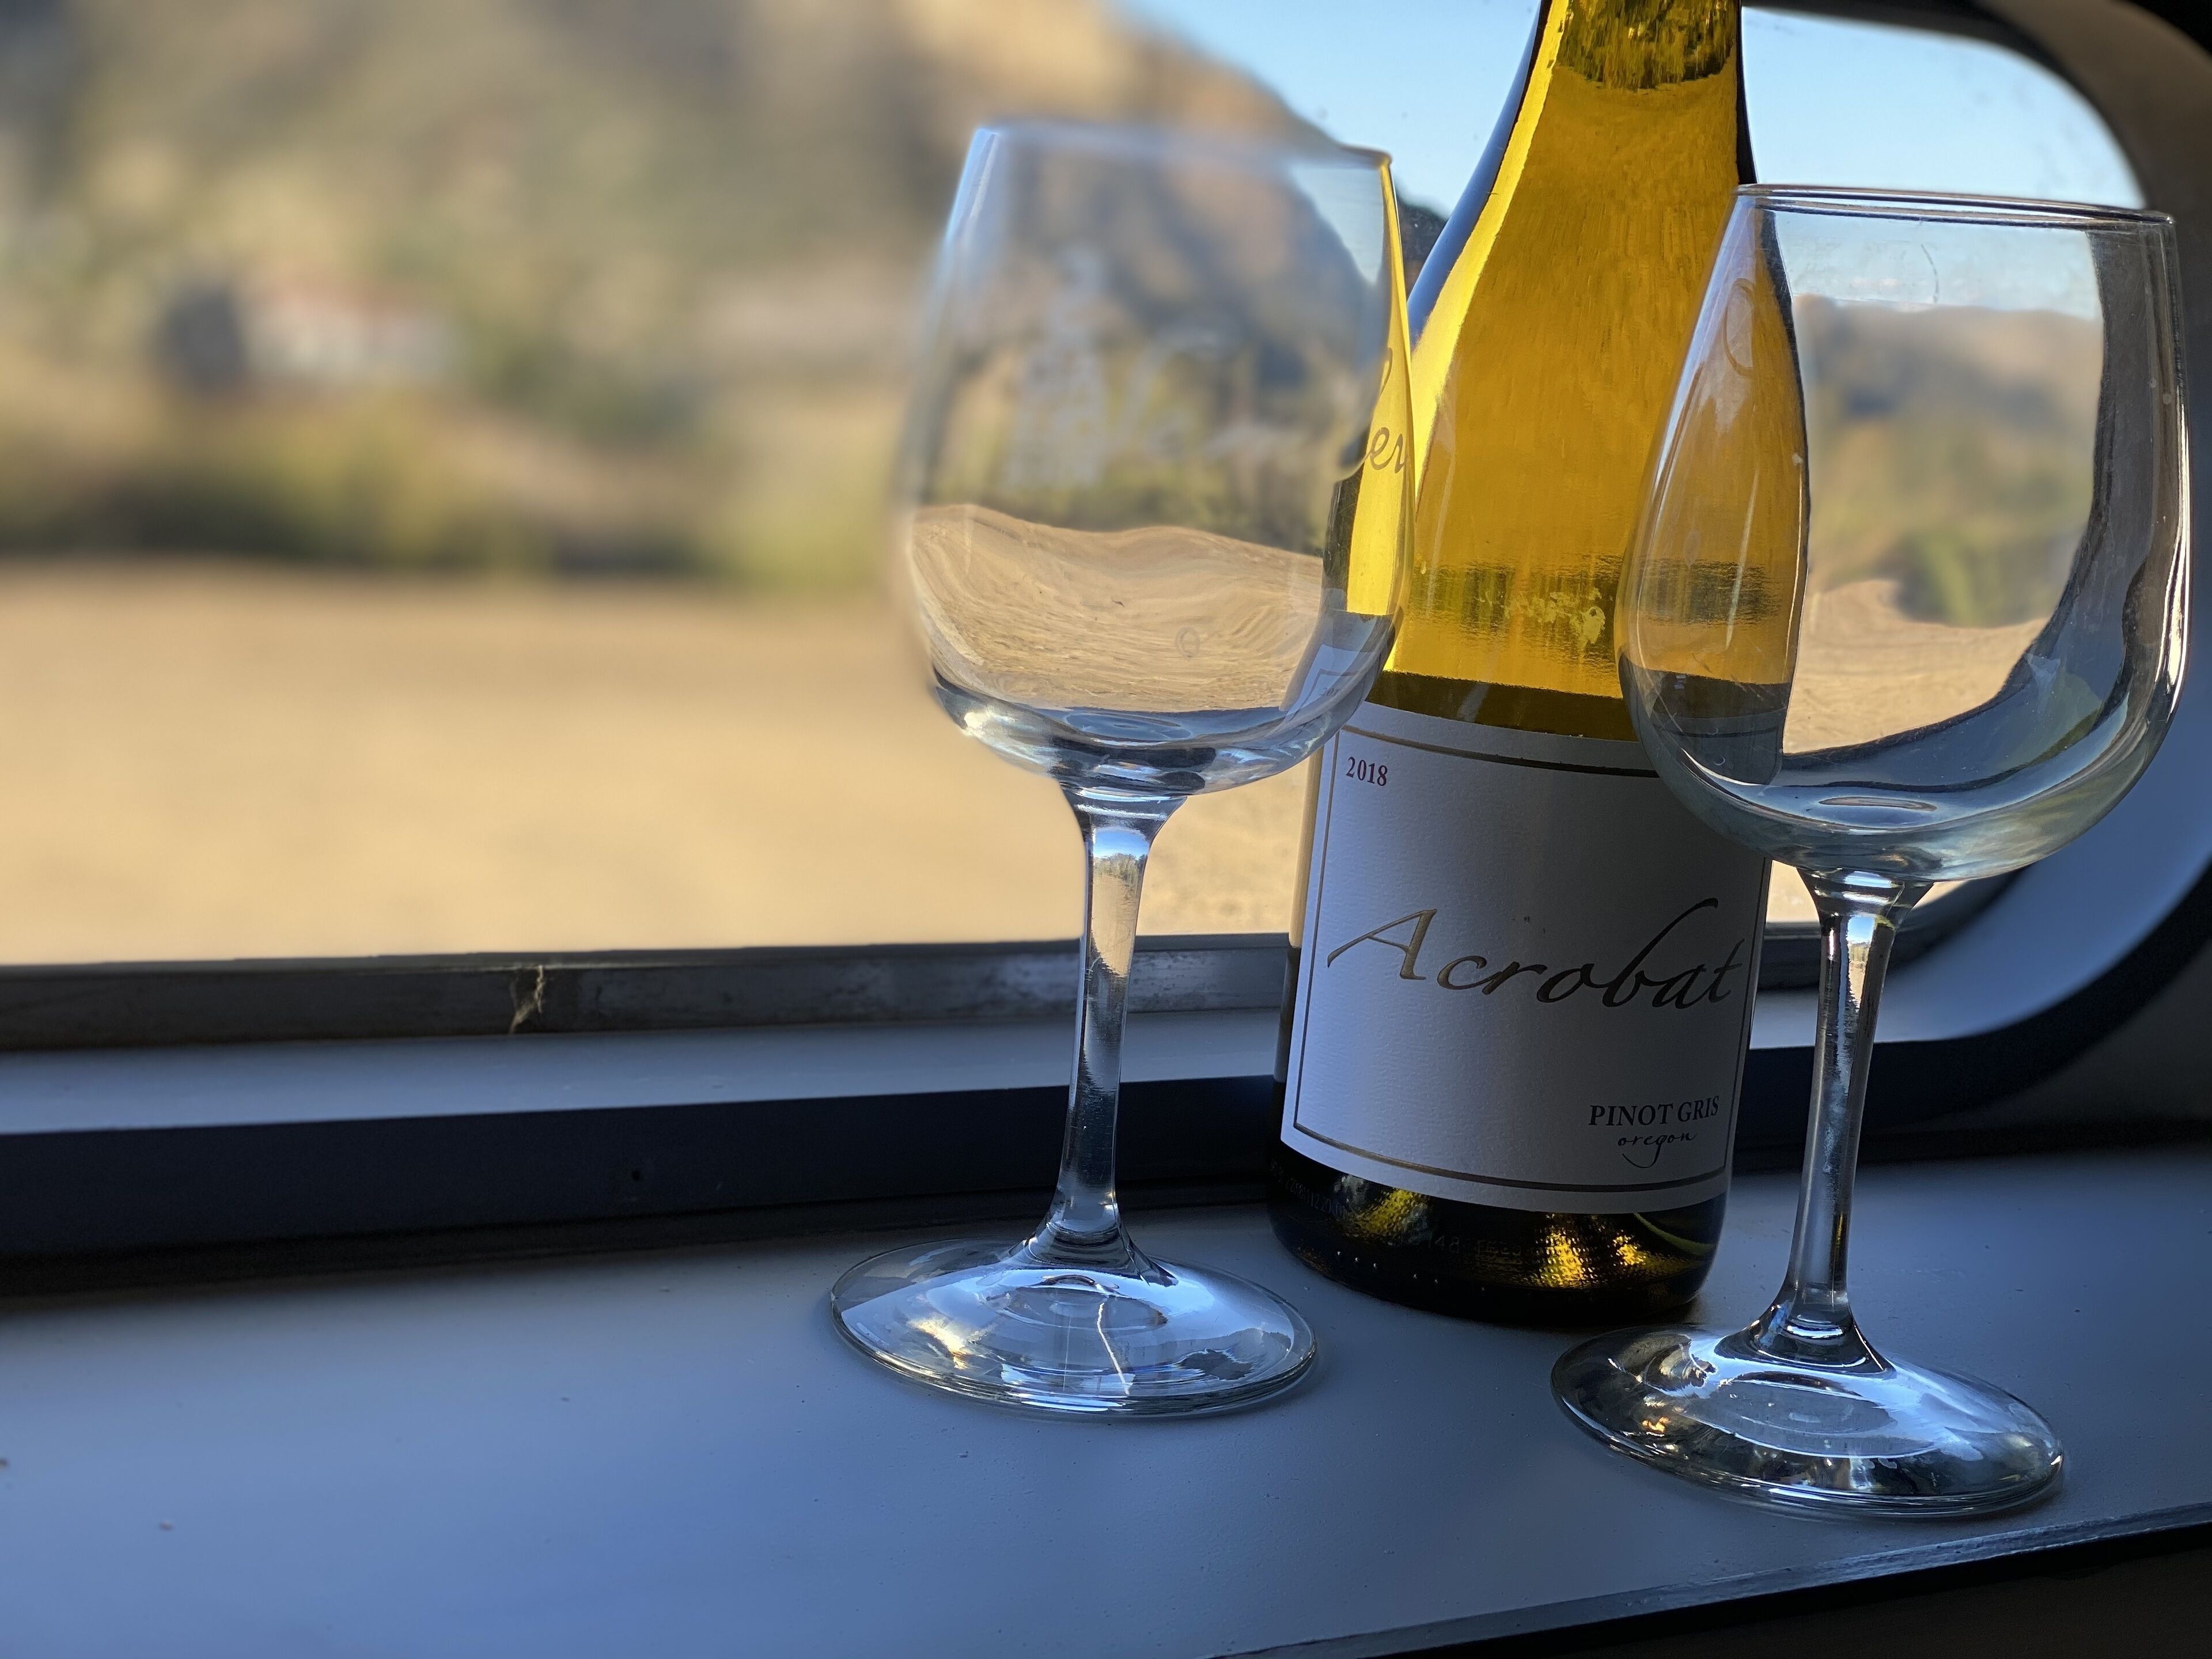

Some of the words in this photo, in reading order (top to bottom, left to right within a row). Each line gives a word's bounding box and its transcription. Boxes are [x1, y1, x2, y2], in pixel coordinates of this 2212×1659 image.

[1346, 756, 1388, 786] 2018
[1327, 897, 1745, 1009] Acrobat
[1588, 1103, 1673, 1126] PINOT
[1677, 1095, 1719, 1122] GRIS
[1618, 1132, 1697, 1169] oregon
